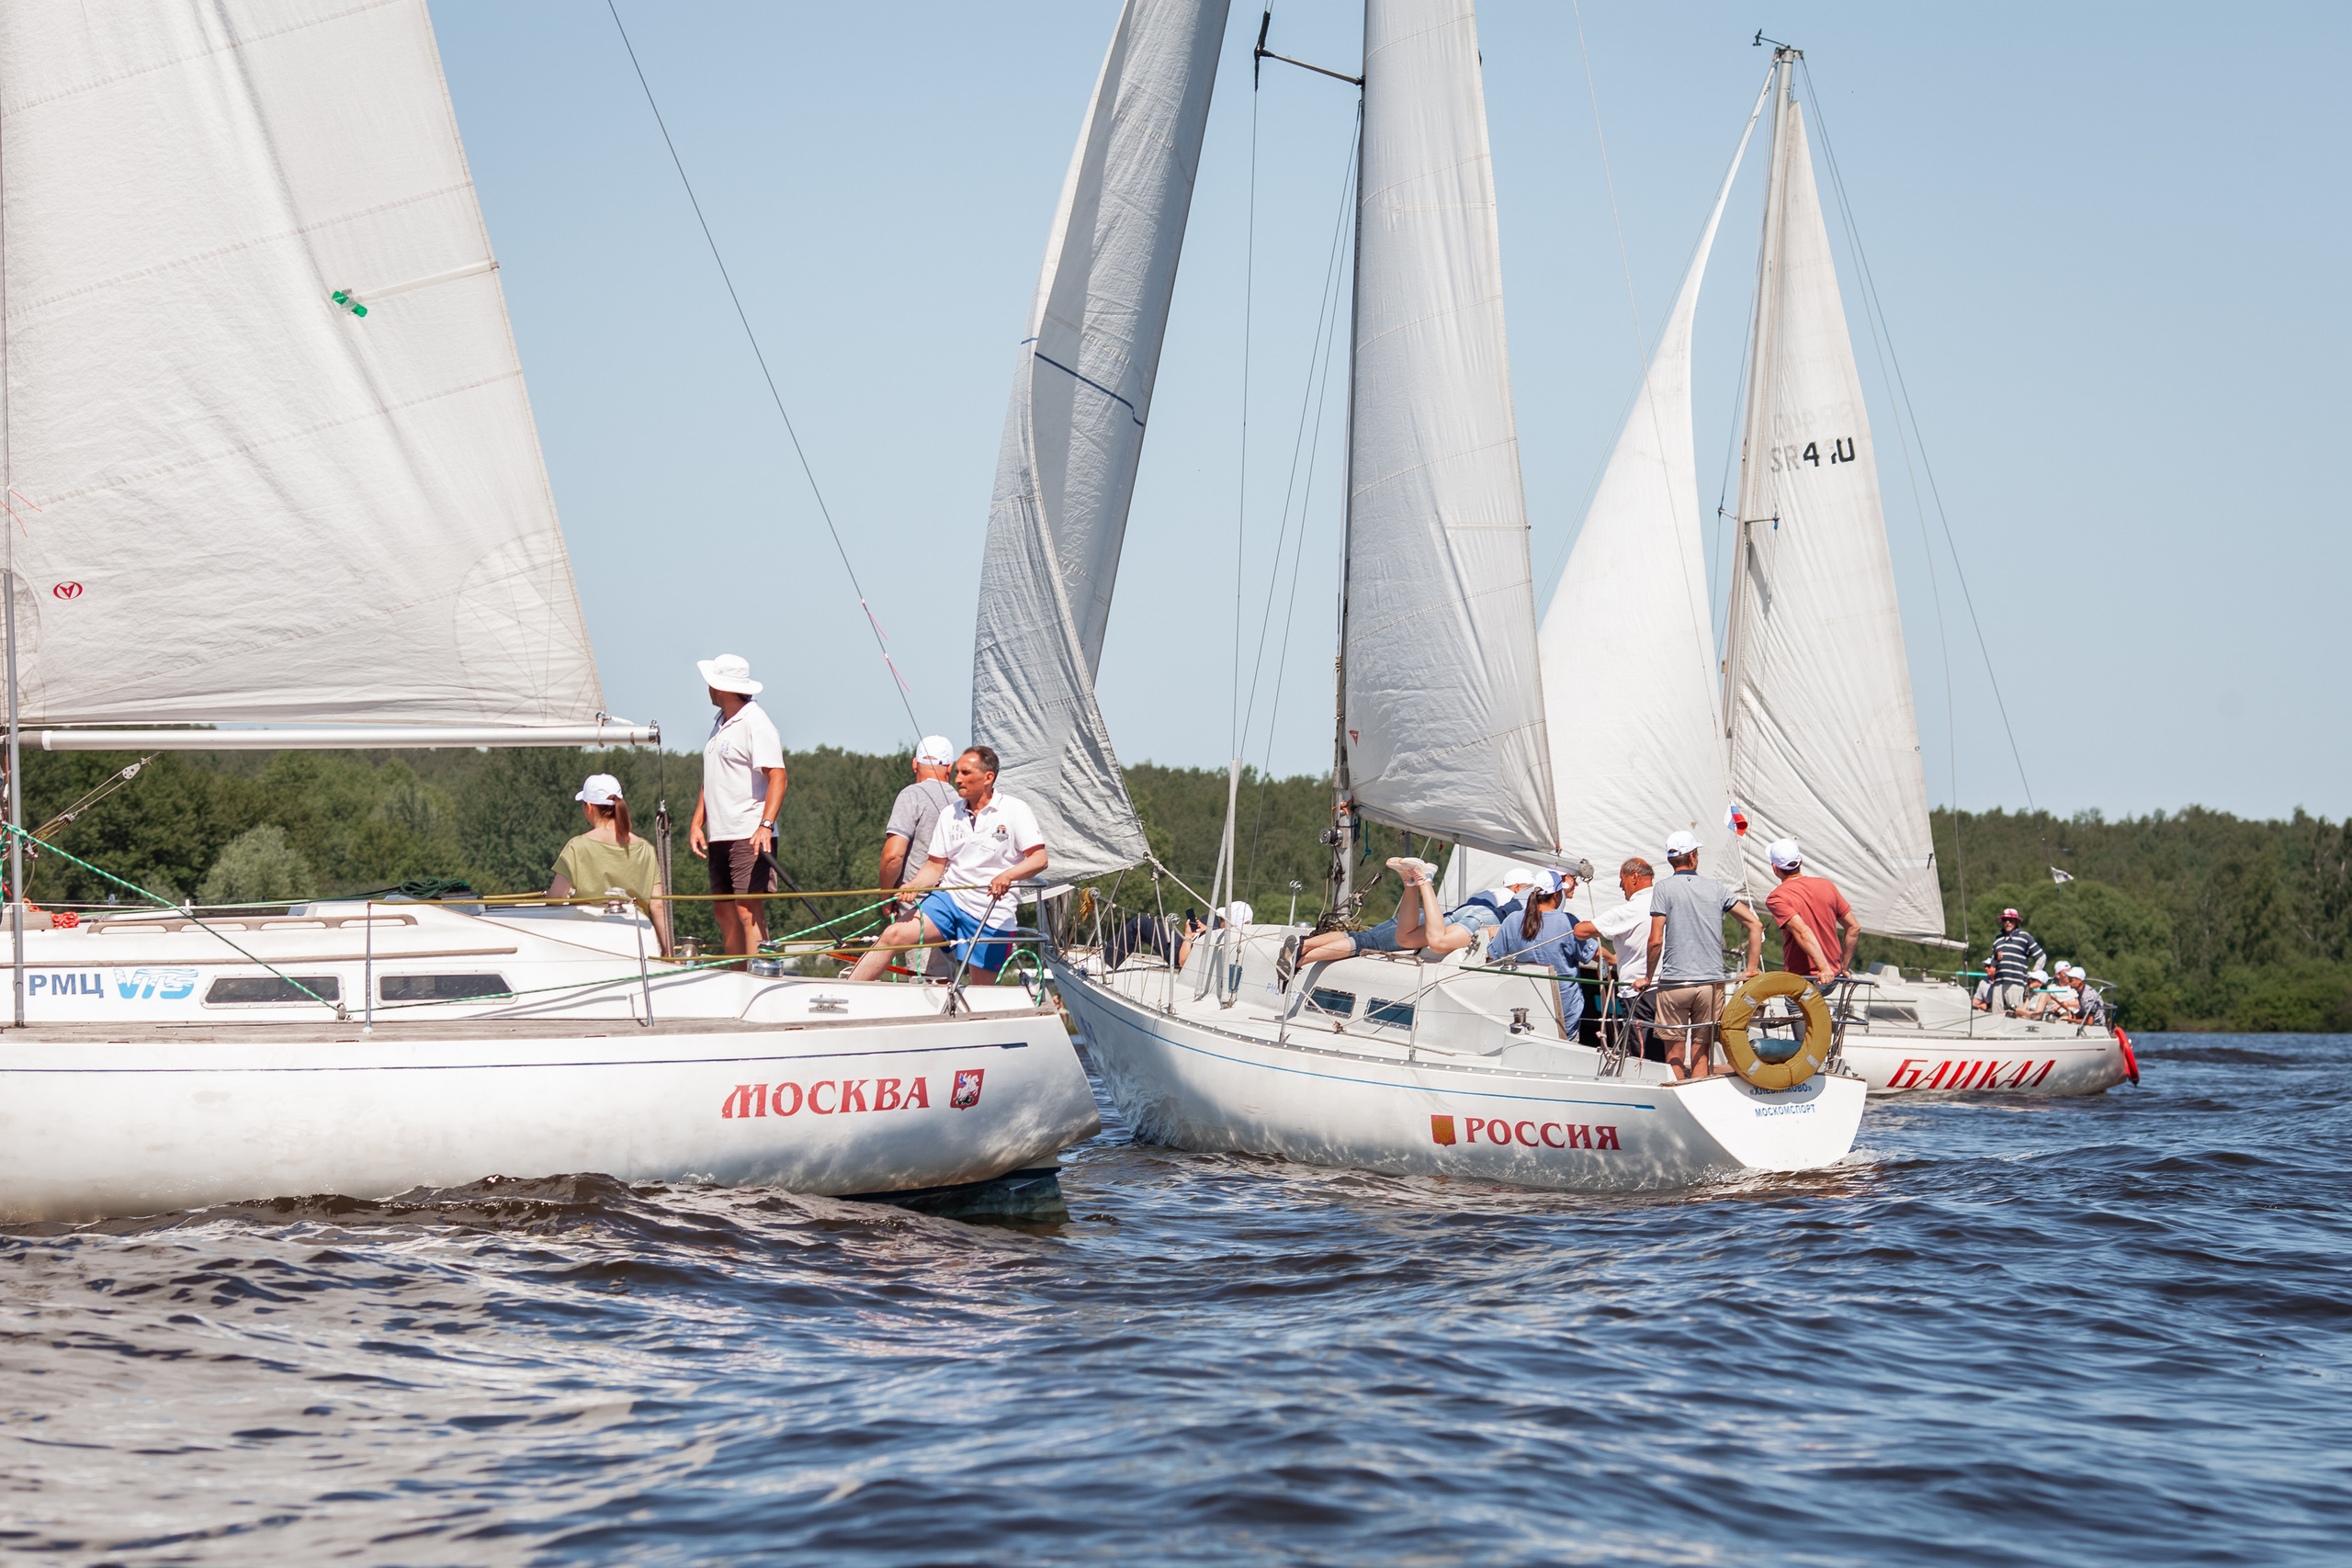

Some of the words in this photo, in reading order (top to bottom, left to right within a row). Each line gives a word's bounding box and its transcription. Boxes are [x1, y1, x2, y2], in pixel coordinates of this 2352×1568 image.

[28, 973, 105, 998] РМЦ
[721, 1077, 931, 1119] МОСКВА
[1754, 1103, 1815, 1118] МОСКОМСПОРТ
[1464, 1117, 1623, 1151] РОССИЯ
